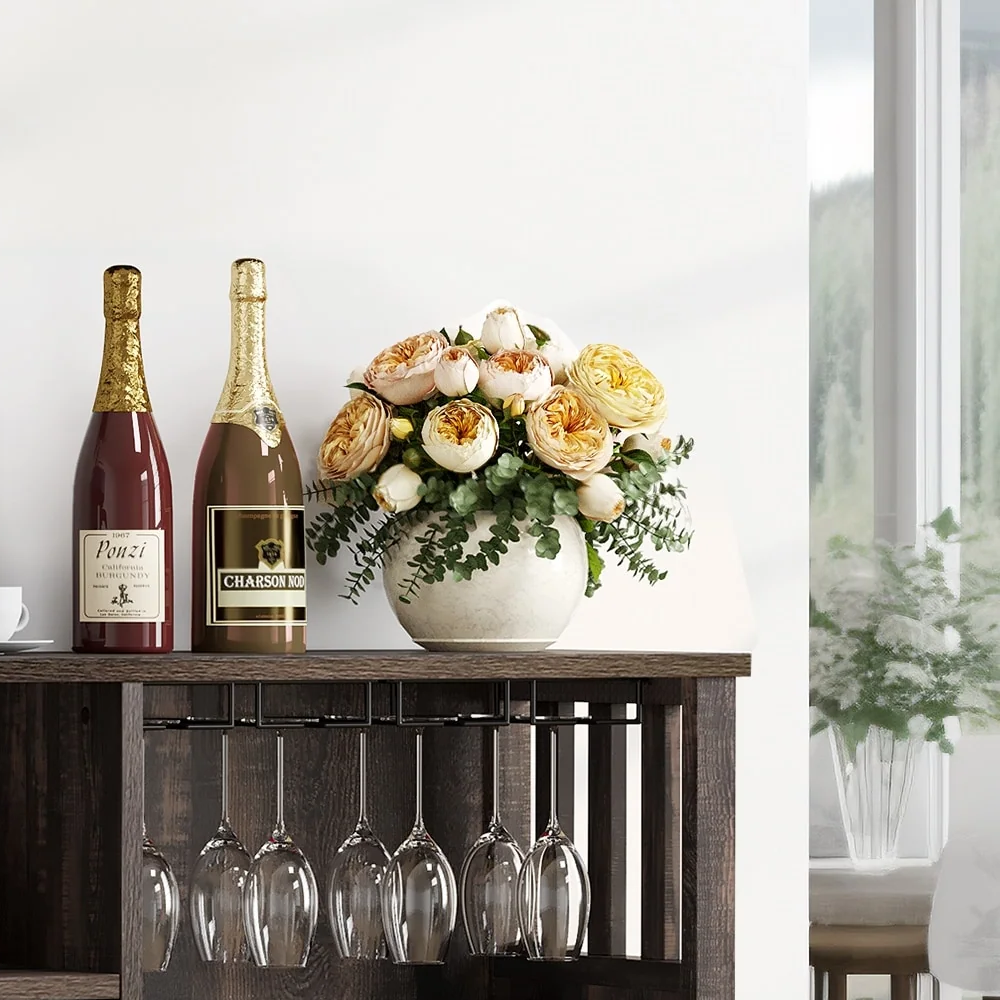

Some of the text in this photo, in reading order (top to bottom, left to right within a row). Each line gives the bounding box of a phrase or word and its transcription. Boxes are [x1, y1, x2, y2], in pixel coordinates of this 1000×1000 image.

[96, 540, 147, 559] Ponzi
[101, 563, 144, 571] California
[223, 575, 286, 588] CHARSON
